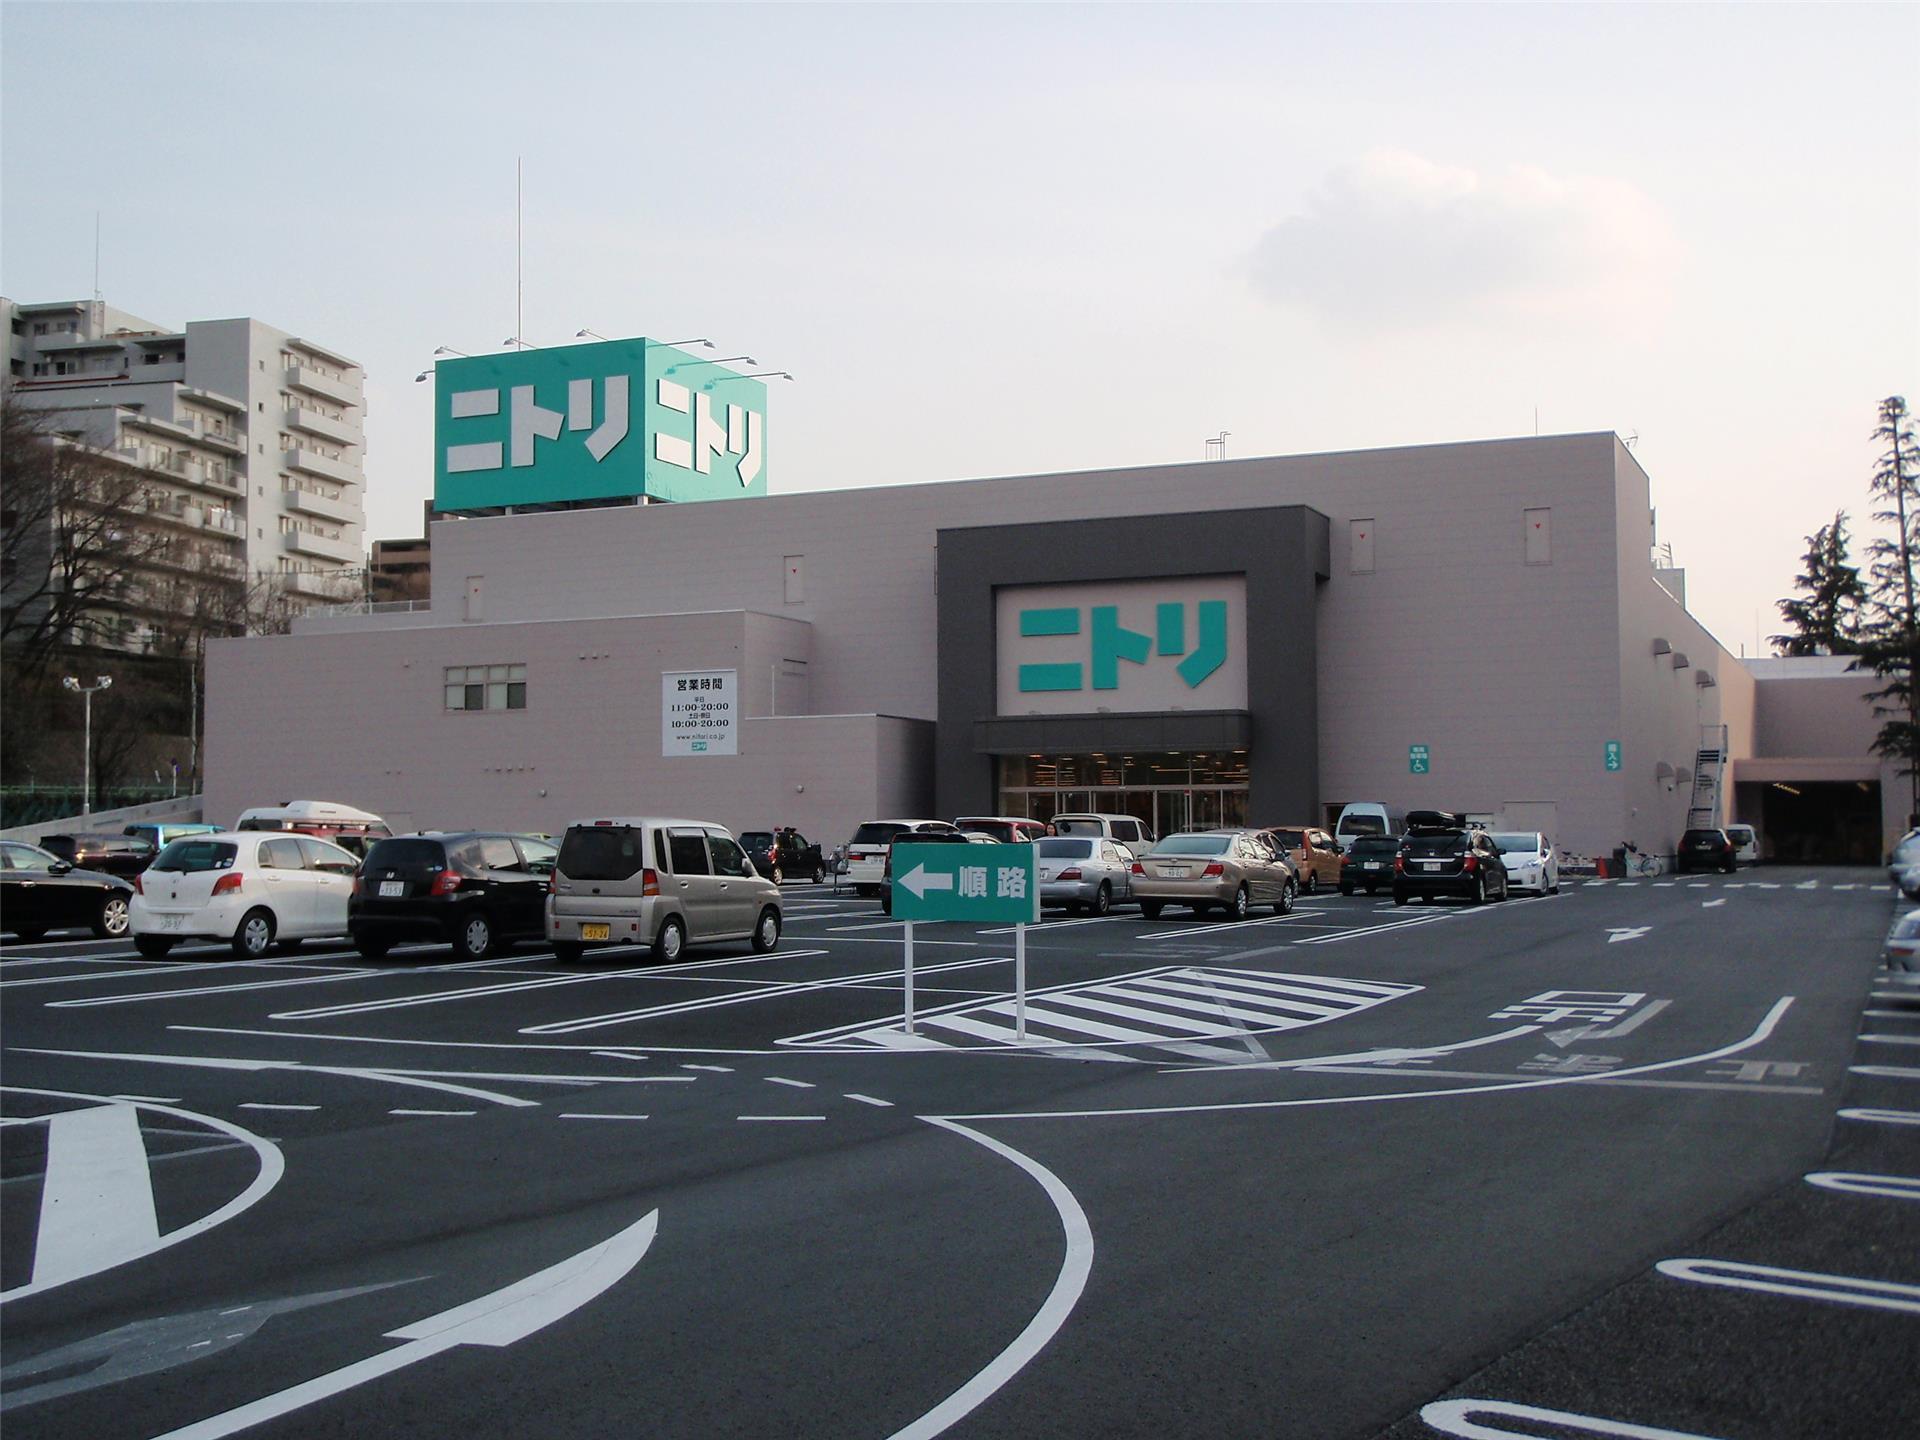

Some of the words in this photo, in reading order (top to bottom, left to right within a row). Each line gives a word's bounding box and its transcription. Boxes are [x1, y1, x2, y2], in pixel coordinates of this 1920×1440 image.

[447, 375, 629, 472] ニトリ
[656, 378, 761, 487] ニトリ
[677, 678, 723, 691] 営業時間
[1018, 601, 1227, 692] ニトリ
[958, 866, 1027, 899] 順路
